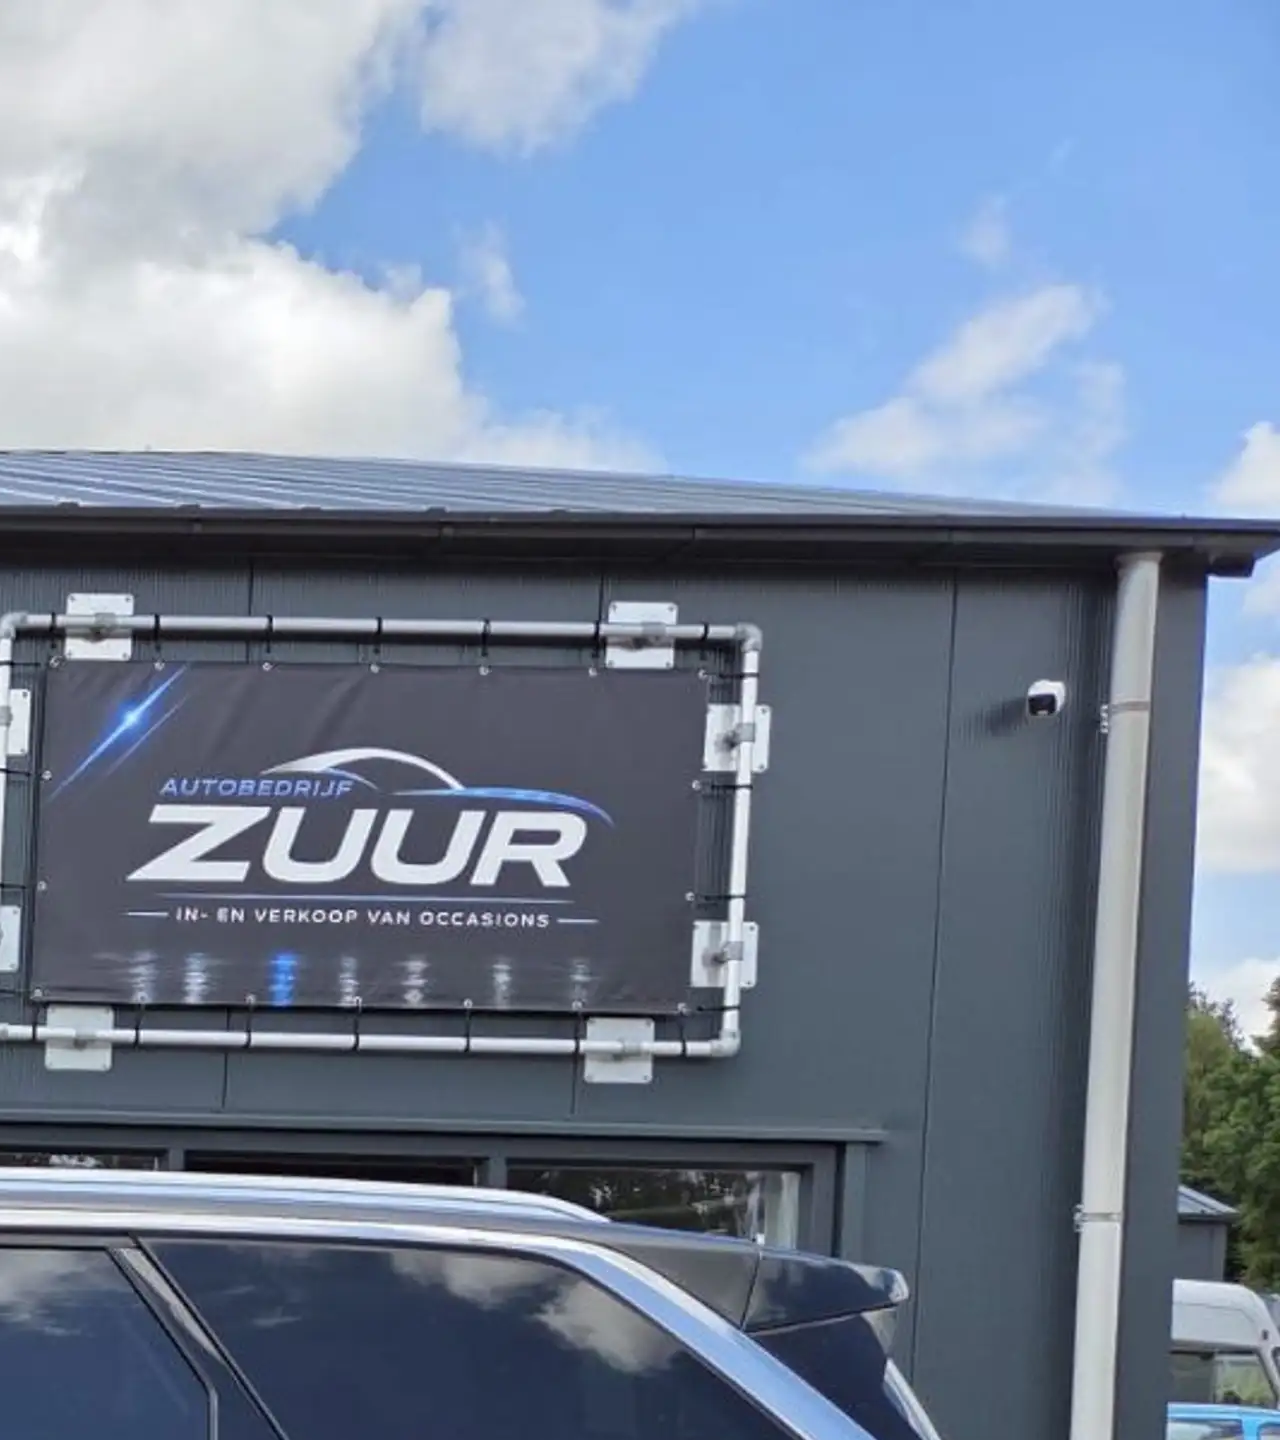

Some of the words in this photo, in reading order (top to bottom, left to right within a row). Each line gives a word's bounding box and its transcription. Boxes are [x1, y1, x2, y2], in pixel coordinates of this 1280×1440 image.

[159, 777, 355, 797] AUTOBEDRIJF
[125, 803, 588, 888] ZUUR
[175, 906, 209, 922] IN-
[216, 906, 245, 923] EN
[254, 907, 358, 924] VERKOOP
[367, 909, 411, 926] VAN
[419, 911, 550, 928] OCCASIONS
